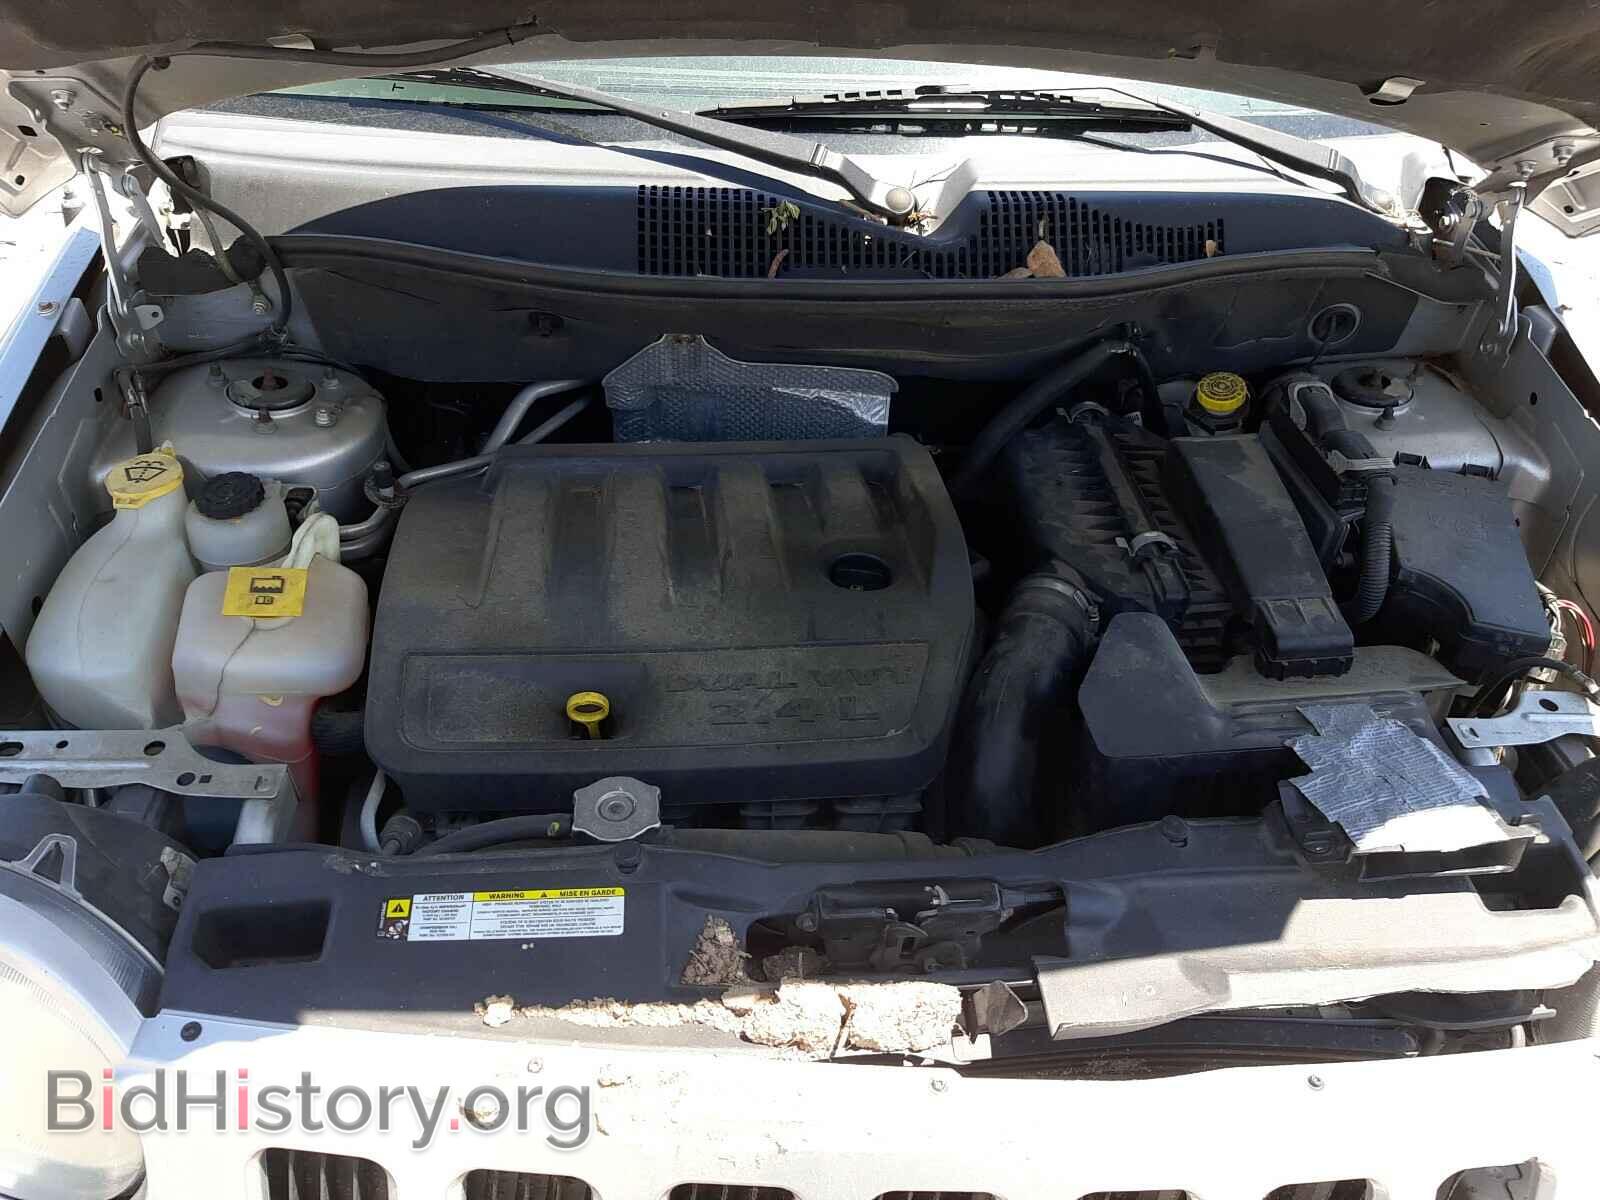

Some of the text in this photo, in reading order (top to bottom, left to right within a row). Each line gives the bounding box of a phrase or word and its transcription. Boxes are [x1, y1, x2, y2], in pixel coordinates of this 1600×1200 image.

[488, 892, 525, 900] WARNING
[560, 889, 578, 897] MISE
[591, 888, 617, 896] GARDE
[422, 894, 465, 902] ATTENTION
